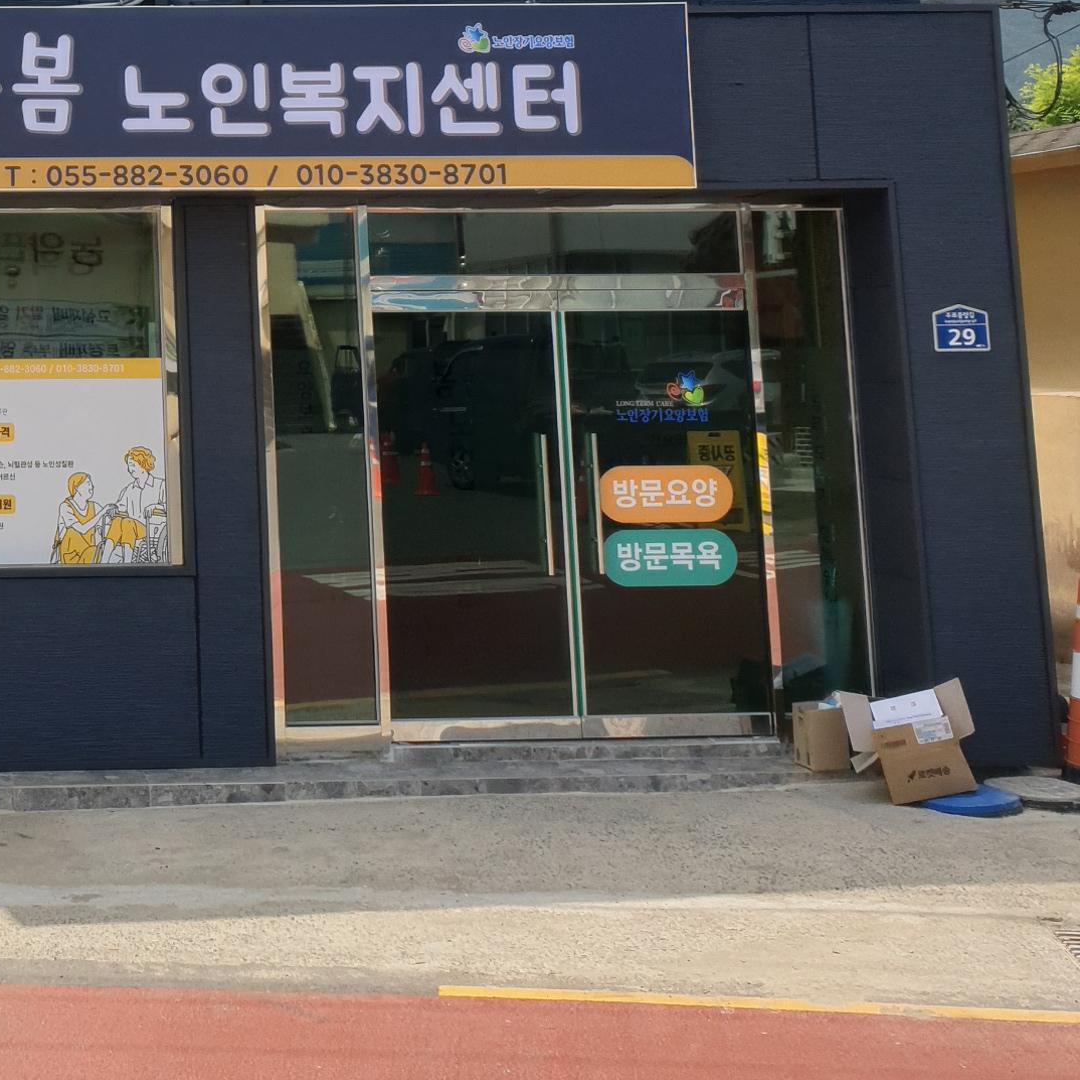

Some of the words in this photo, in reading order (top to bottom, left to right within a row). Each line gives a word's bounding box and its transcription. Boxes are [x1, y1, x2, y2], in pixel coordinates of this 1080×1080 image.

[491, 34, 575, 49] 노인장기요양보험
[122, 60, 582, 137] 노인복지센터
[46, 164, 249, 187] 055-882-3060
[296, 163, 507, 186] 010-3830-8701
[948, 328, 976, 346] 29
[56, 363, 124, 373] 010-3830-8701
[616, 408, 709, 423] 노인장기요양보험
[613, 479, 718, 509] 방문요양
[617, 541, 722, 572] 방문목욕
